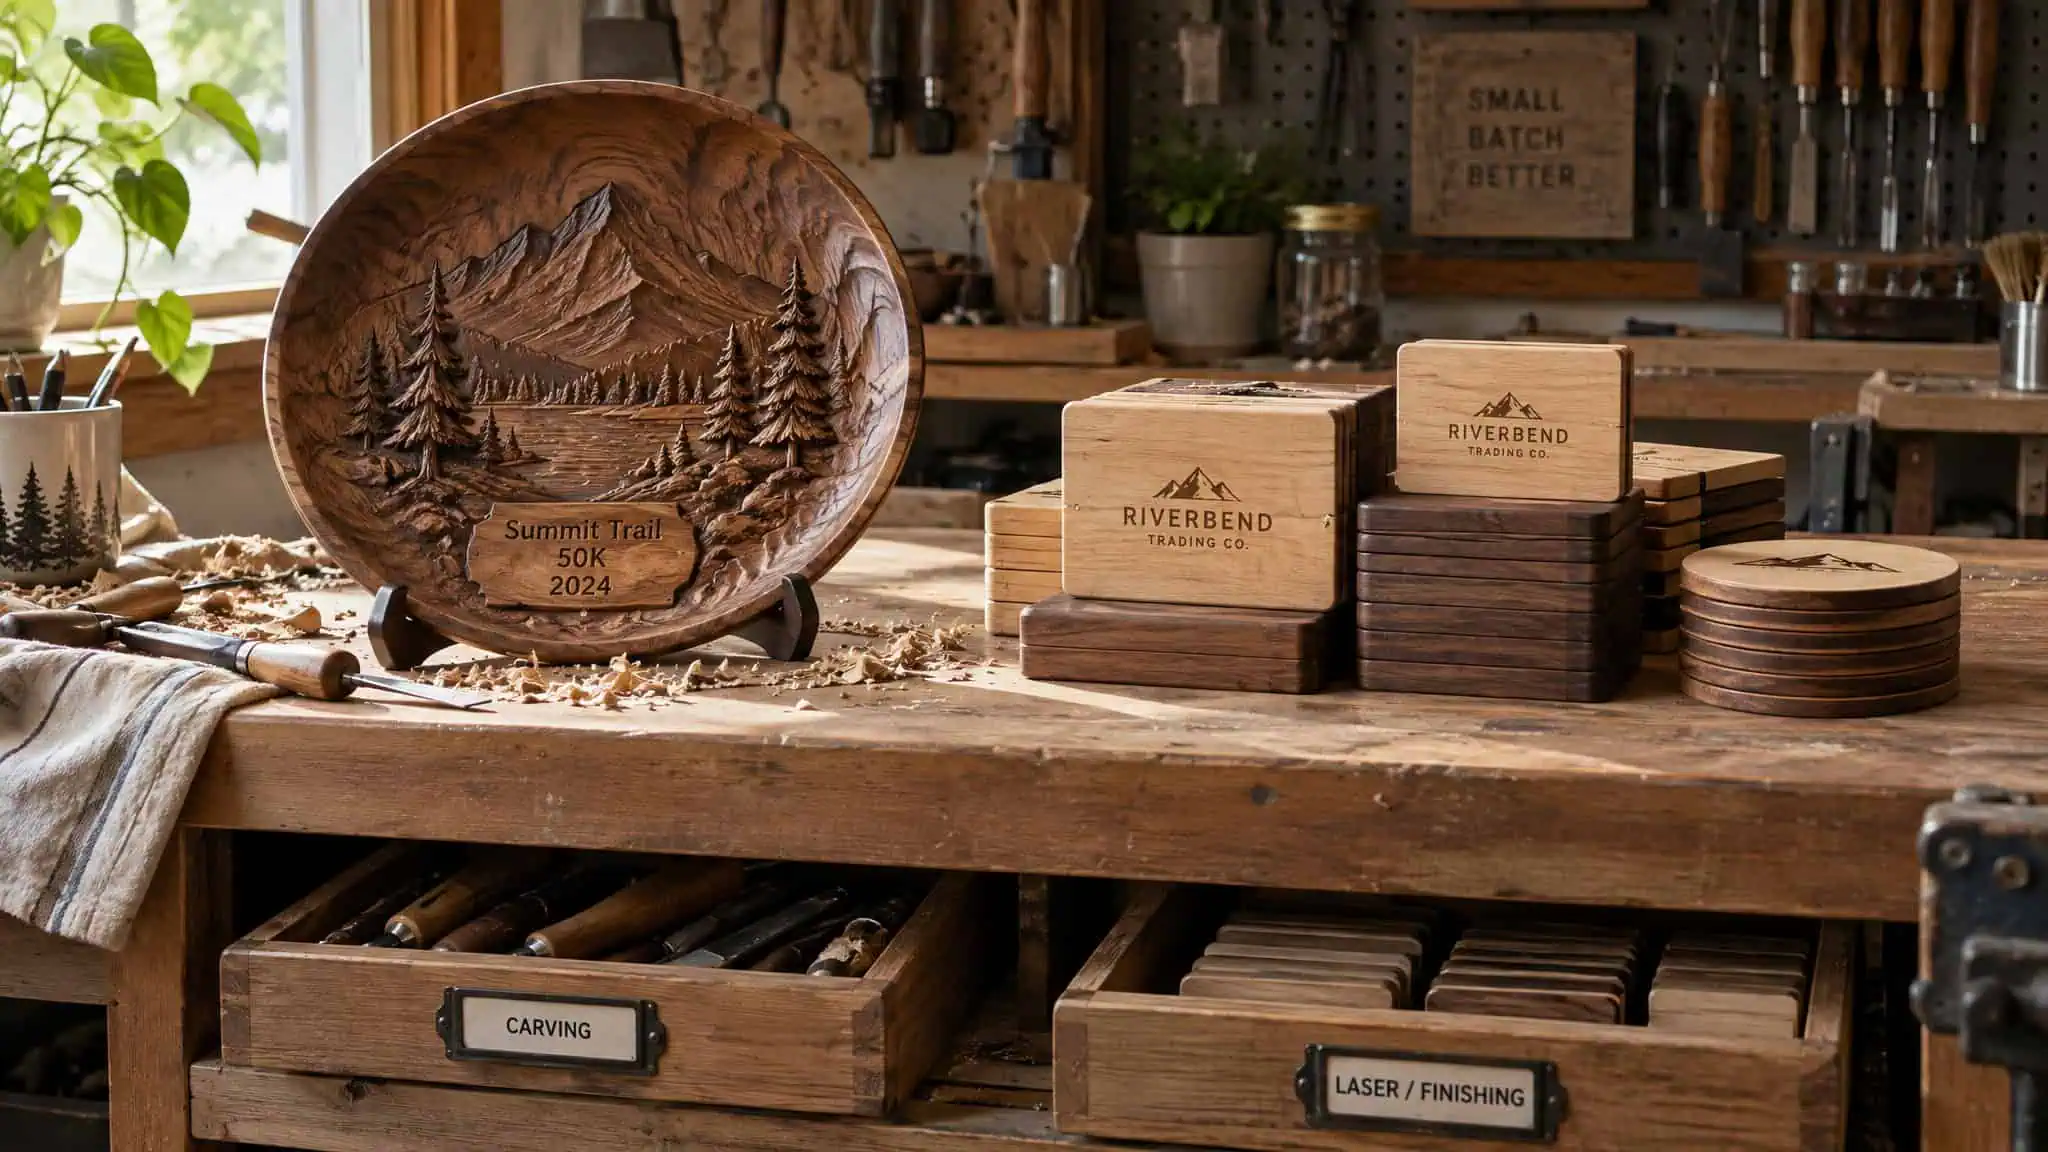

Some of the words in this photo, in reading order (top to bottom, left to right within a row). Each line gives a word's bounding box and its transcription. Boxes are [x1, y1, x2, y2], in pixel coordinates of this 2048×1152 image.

[1467, 87, 1564, 112] SMALL
[1467, 125, 1564, 151] BATCH
[1467, 163, 1576, 189] BETTER
[1448, 423, 1569, 444] RIVERBEND
[1468, 446, 1524, 458] TRADING
[1529, 449, 1551, 459] CO.
[504, 519, 600, 541] Summit
[608, 518, 663, 540] Trail
[1123, 506, 1273, 532] RIVERBEND
[1148, 534, 1216, 548] TRADING
[1223, 538, 1249, 550] CO.
[557, 547, 607, 569] 50K
[550, 575, 613, 596] 2024
[506, 1016, 591, 1040] CARVING
[1335, 1075, 1400, 1099] LASER
[1404, 1080, 1415, 1101] /
[1420, 1082, 1525, 1108] FINISHING
